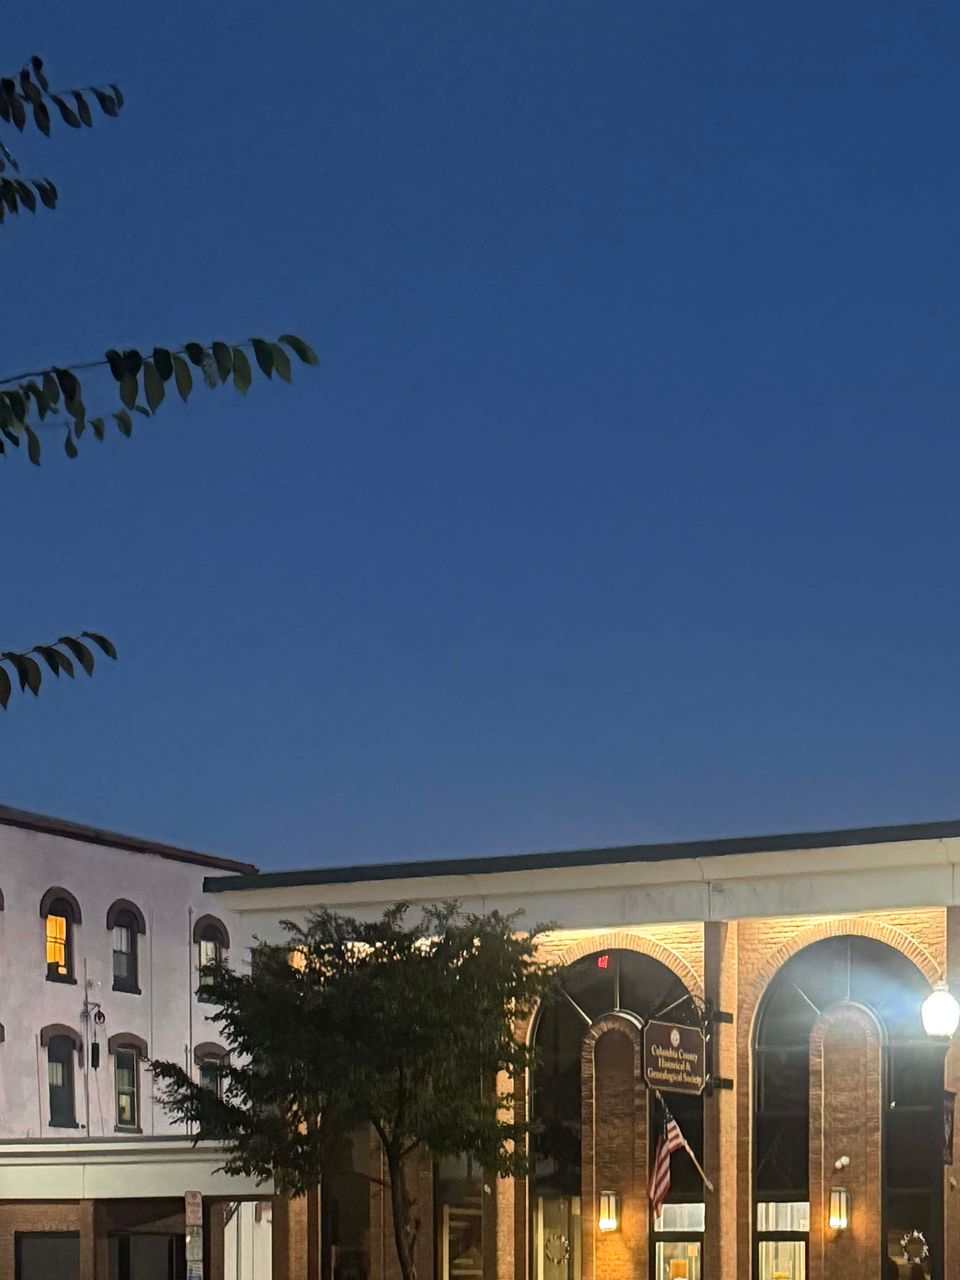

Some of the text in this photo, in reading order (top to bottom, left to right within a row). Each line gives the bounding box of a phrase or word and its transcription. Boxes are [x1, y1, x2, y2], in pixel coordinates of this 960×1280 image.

[651, 1044, 698, 1063] Columbia County
[658, 1056, 685, 1071] Historical
[647, 1067, 702, 1087] Genealogical Society
